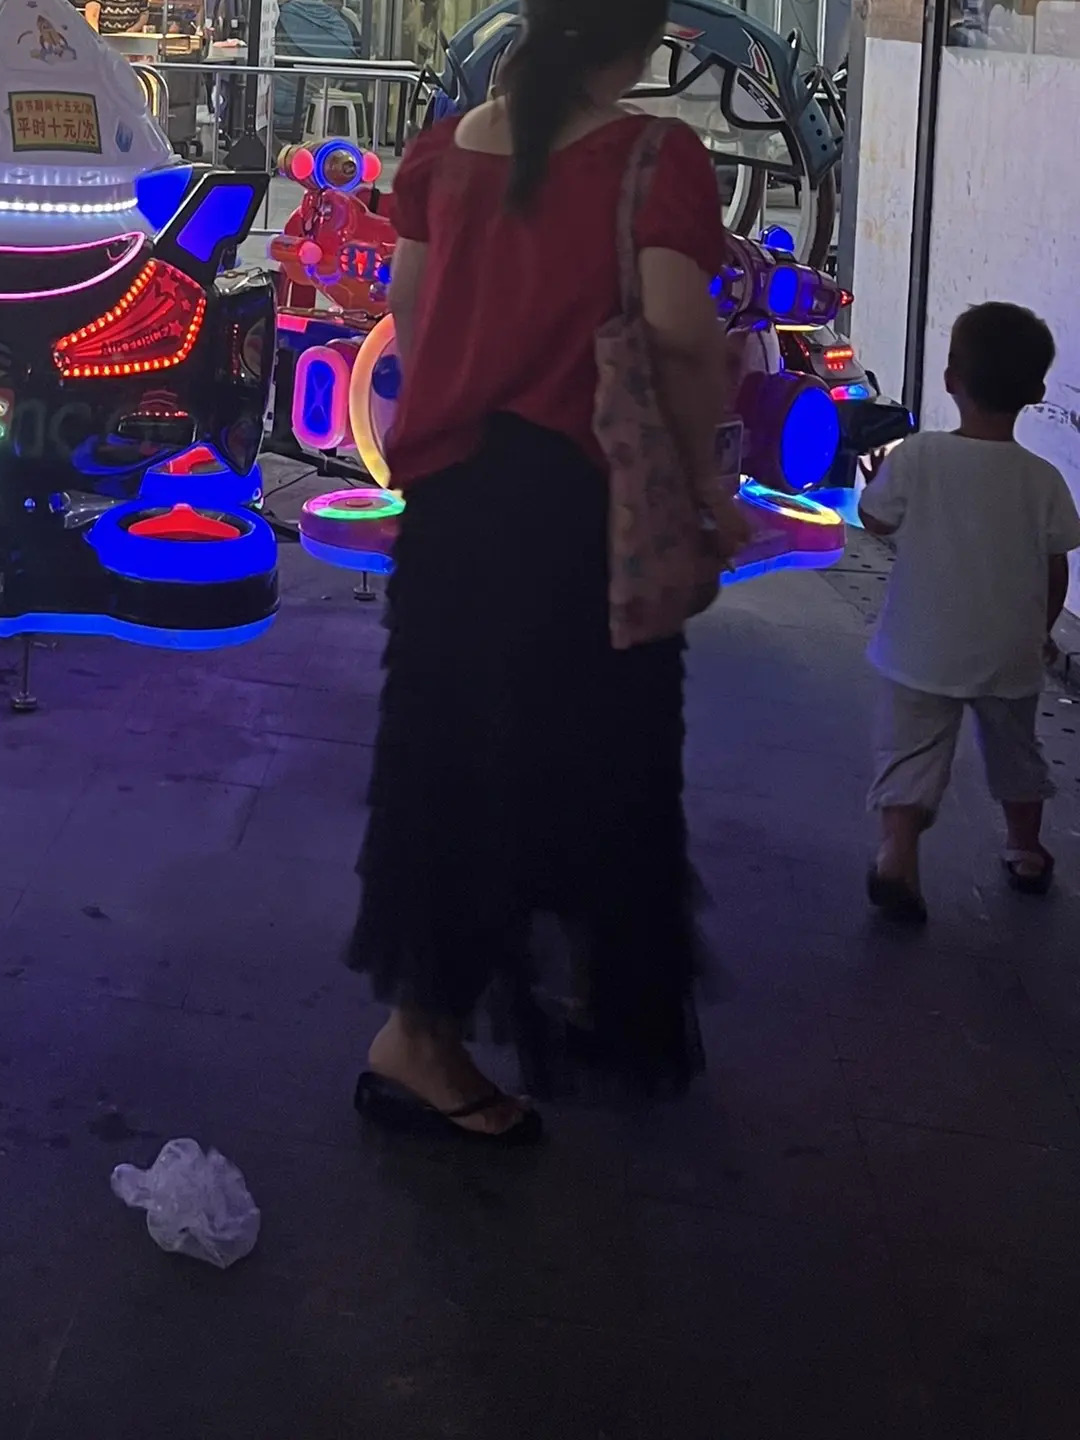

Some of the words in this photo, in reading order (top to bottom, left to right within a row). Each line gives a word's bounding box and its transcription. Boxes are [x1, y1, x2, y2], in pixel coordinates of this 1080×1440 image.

[17, 117, 96, 139] 平时十元/次
